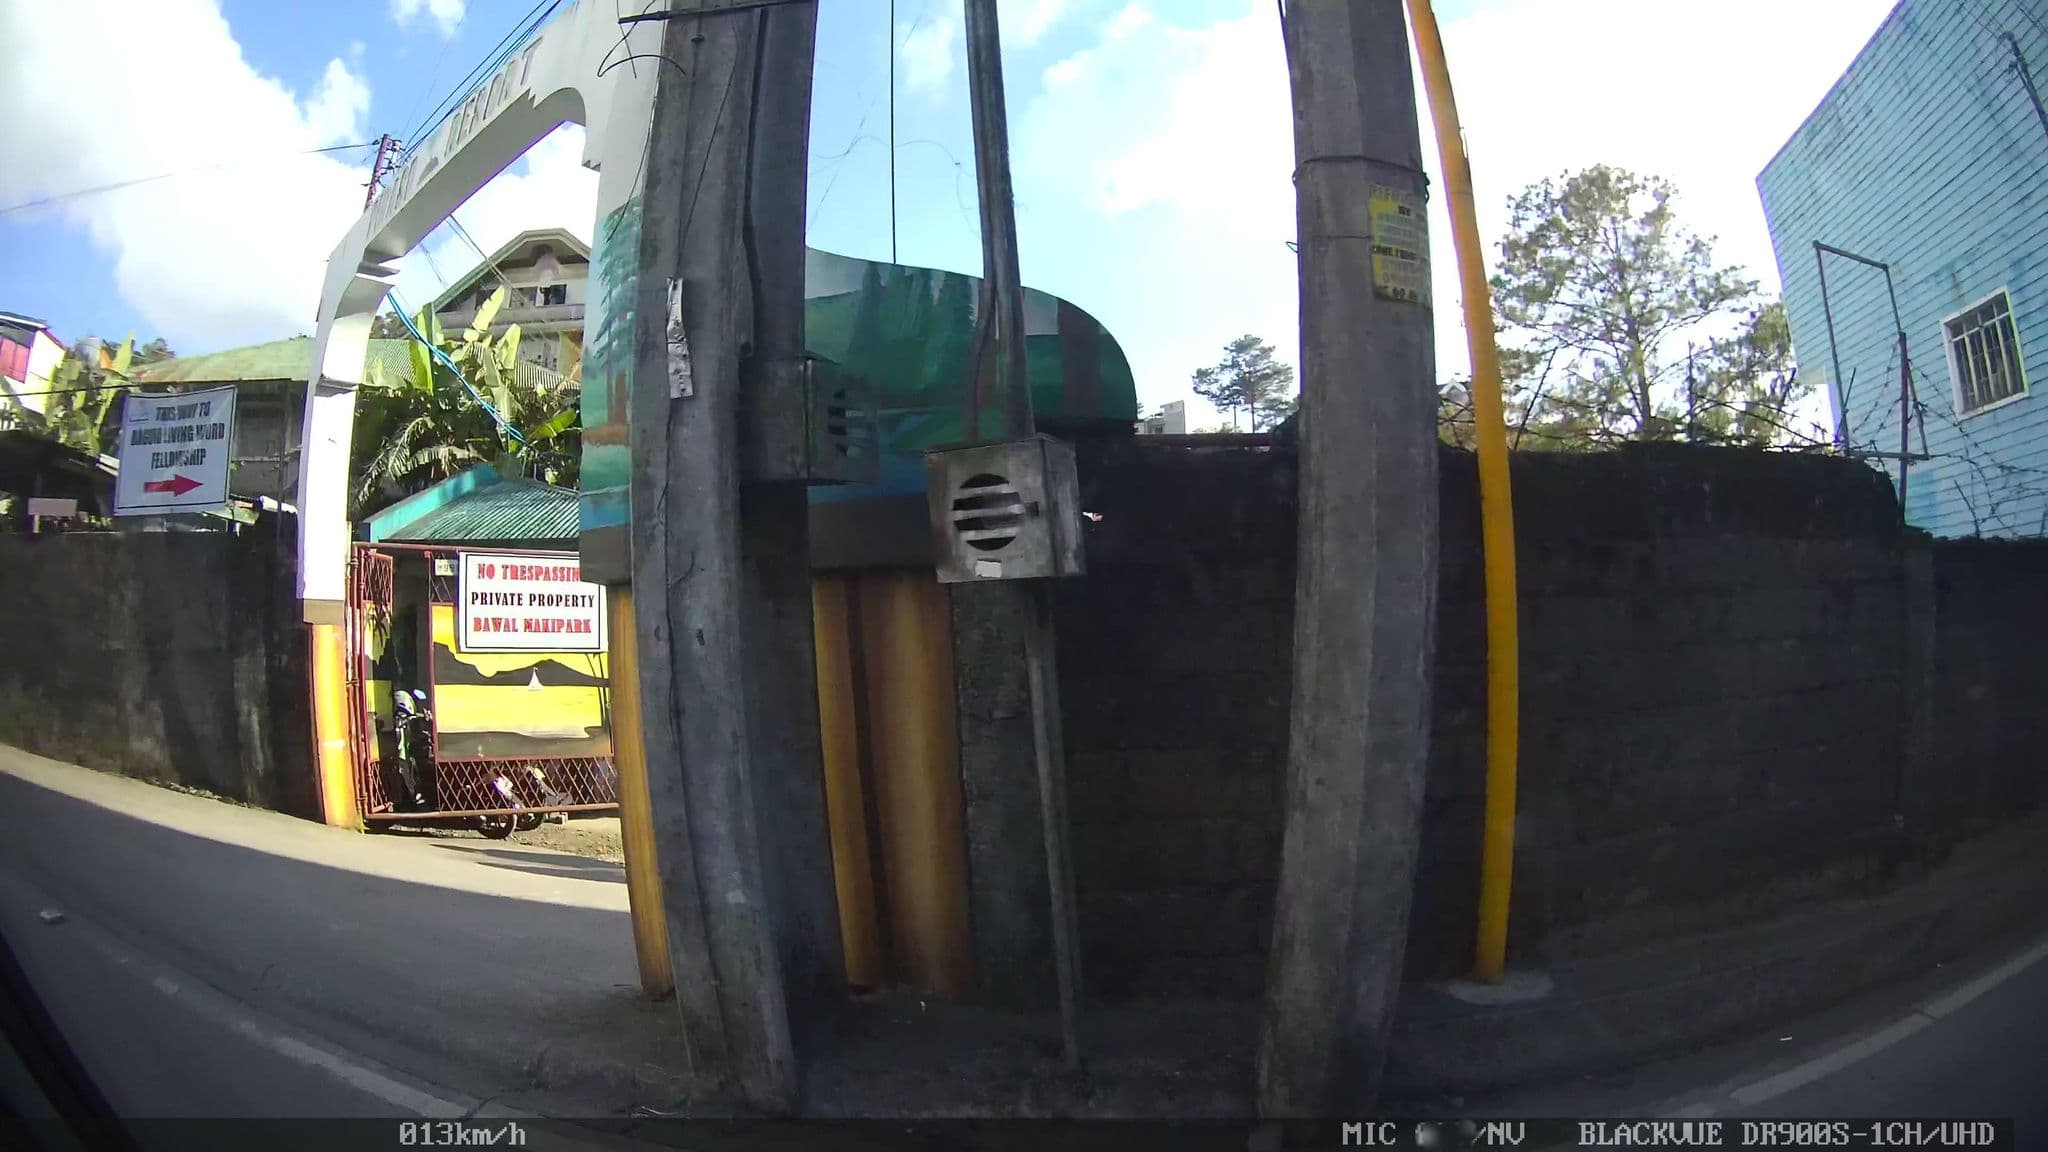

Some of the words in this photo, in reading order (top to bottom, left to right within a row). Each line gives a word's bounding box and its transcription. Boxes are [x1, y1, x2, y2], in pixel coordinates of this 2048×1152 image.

[199, 401, 211, 416] TO
[163, 424, 194, 444] LIVING
[196, 422, 225, 440] WORD
[151, 448, 207, 470] FELLOWSHIP
[477, 563, 495, 579] NO
[502, 564, 581, 582] TRESPASSIN
[471, 591, 523, 606] PRIVATE
[529, 594, 595, 608] PROPERTY
[473, 617, 518, 632] BAWAL
[524, 618, 591, 633] MAKIPARK
